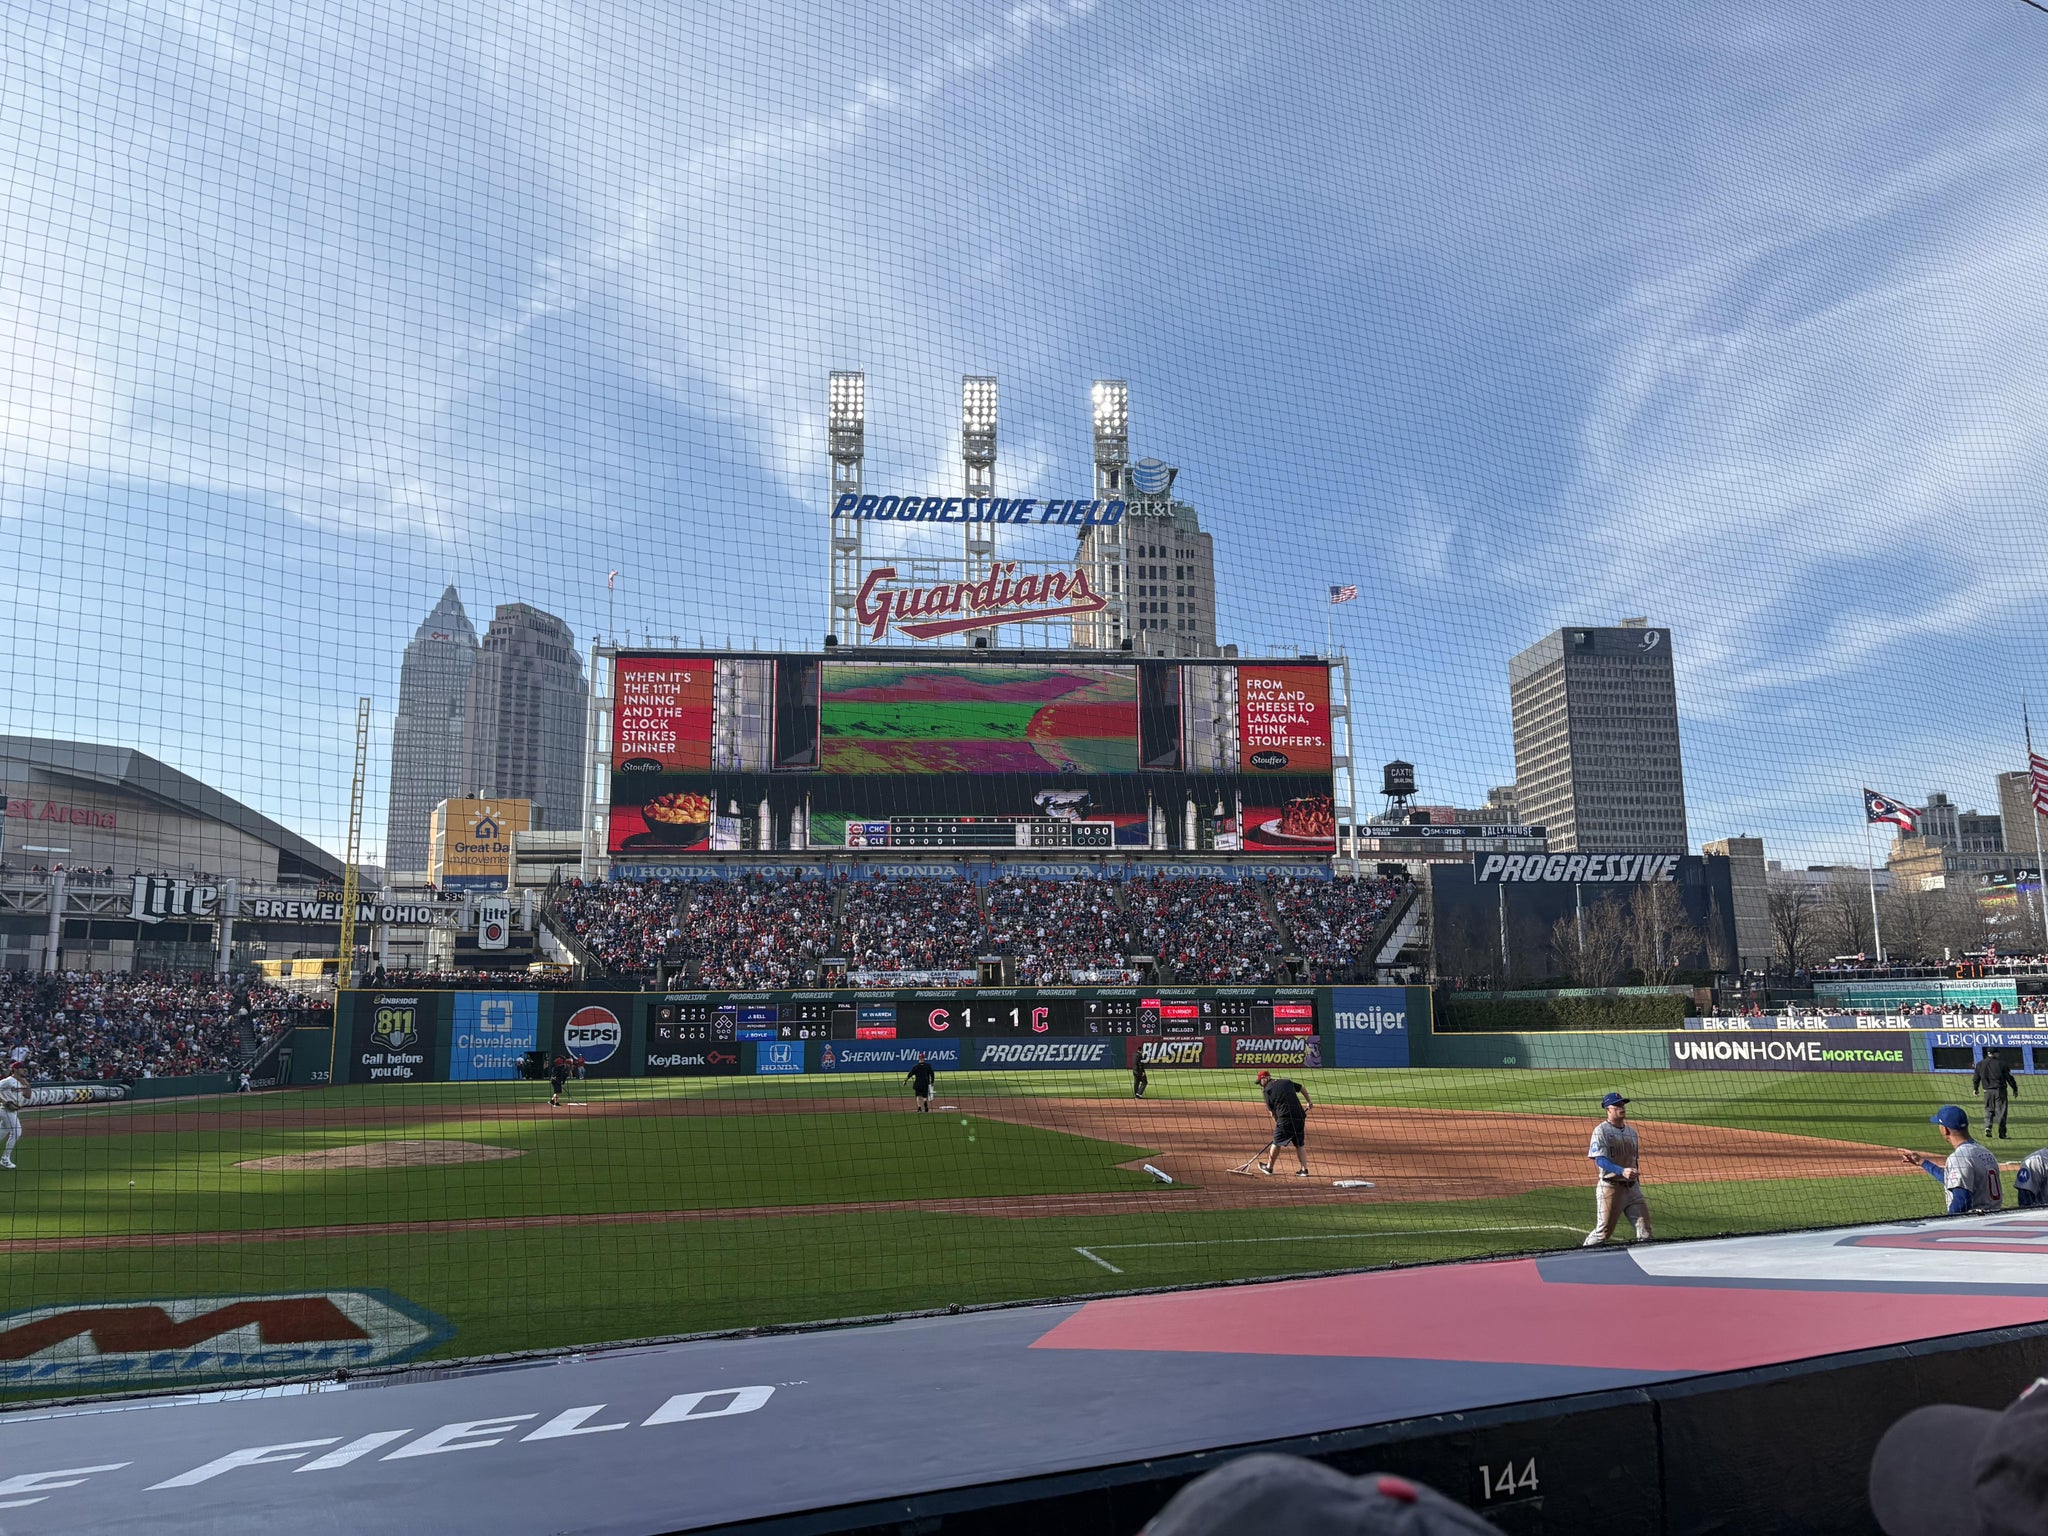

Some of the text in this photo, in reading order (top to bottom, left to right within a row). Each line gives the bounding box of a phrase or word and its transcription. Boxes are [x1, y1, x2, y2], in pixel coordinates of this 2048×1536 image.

[831, 494, 1127, 526] PROGRESSIVE FIELD
[1129, 497, 1175, 516] at&t
[854, 561, 1107, 643] Guardians
[1643, 630, 1660, 651] 9
[624, 672, 691, 683] WHEN IT'S
[624, 683, 681, 694] THE 11TH
[1247, 679, 1283, 689] FROM
[624, 695, 675, 706] INNING
[1247, 691, 1305, 701] MAC AND
[623, 707, 682, 718] AND THE
[1247, 702, 1315, 712] CHEESE TO
[622, 719, 668, 729] CLOCK
[1248, 714, 1309, 725] LASAGNA,
[622, 731, 677, 741] STRIKES
[1248, 725, 1287, 735] THINK
[621, 743, 676, 753] DINNER
[1251, 754, 1287, 766] Stouffer's
[6, 799, 117, 829] et Arena
[1482, 827, 1533, 837] RALLY HOUSE
[454, 842, 510, 853] Great Da
[639, 866, 720, 877] HONDA
[881, 865, 958, 876] HONDA
[1017, 865, 1098, 876] HONDA
[1251, 866, 1324, 876] HONDA
[1480, 854, 1680, 882] PROGRESSIVE
[127, 876, 219, 923] Lite
[318, 891, 375, 904] PRODLY
[356, 905, 376, 922] IN
[382, 906, 430, 923] OHIO
[483, 907, 508, 923] Lite
[1956, 965, 1984, 980] 2:11
[1618, 985, 1670, 995] PROGRESSIVE
[1934, 981, 1971, 989] Cleveland
[664, 993, 709, 1001] PROGRESSIVE
[915, 990, 957, 998] PROGRESSIVE
[377, 1010, 412, 1034] 811
[929, 1008, 949, 1031] C
[961, 1008, 971, 1027] 1
[1009, 1008, 1019, 1026] 1
[1032, 1007, 1049, 1032] C
[1335, 1006, 1405, 1034] meijer
[567, 1029, 618, 1041] PEPSI
[458, 1034, 532, 1049] Cleveland
[1235, 1039, 1305, 1051] PHANTOM
[362, 1053, 423, 1064] Call before
[981, 1044, 1106, 1062] PROGRESSIVE
[1141, 1042, 1203, 1064] BLASTER
[1235, 1053, 1304, 1064] FIREWORKS
[1822, 1050, 1903, 1062] MORTGAGE
[473, 1054, 516, 1068] Clinic
[648, 1054, 705, 1067] KeyBank
[1502, 1057, 1516, 1065] 400
[311, 1071, 329, 1080] 325
[371, 1066, 413, 1079] you dig.
[1988, 1169, 2001, 1200] 0
[0, 1346, 374, 1379] arathon
[143, 1385, 776, 1491] FIELD
[1479, 1456, 1539, 1499] 144
